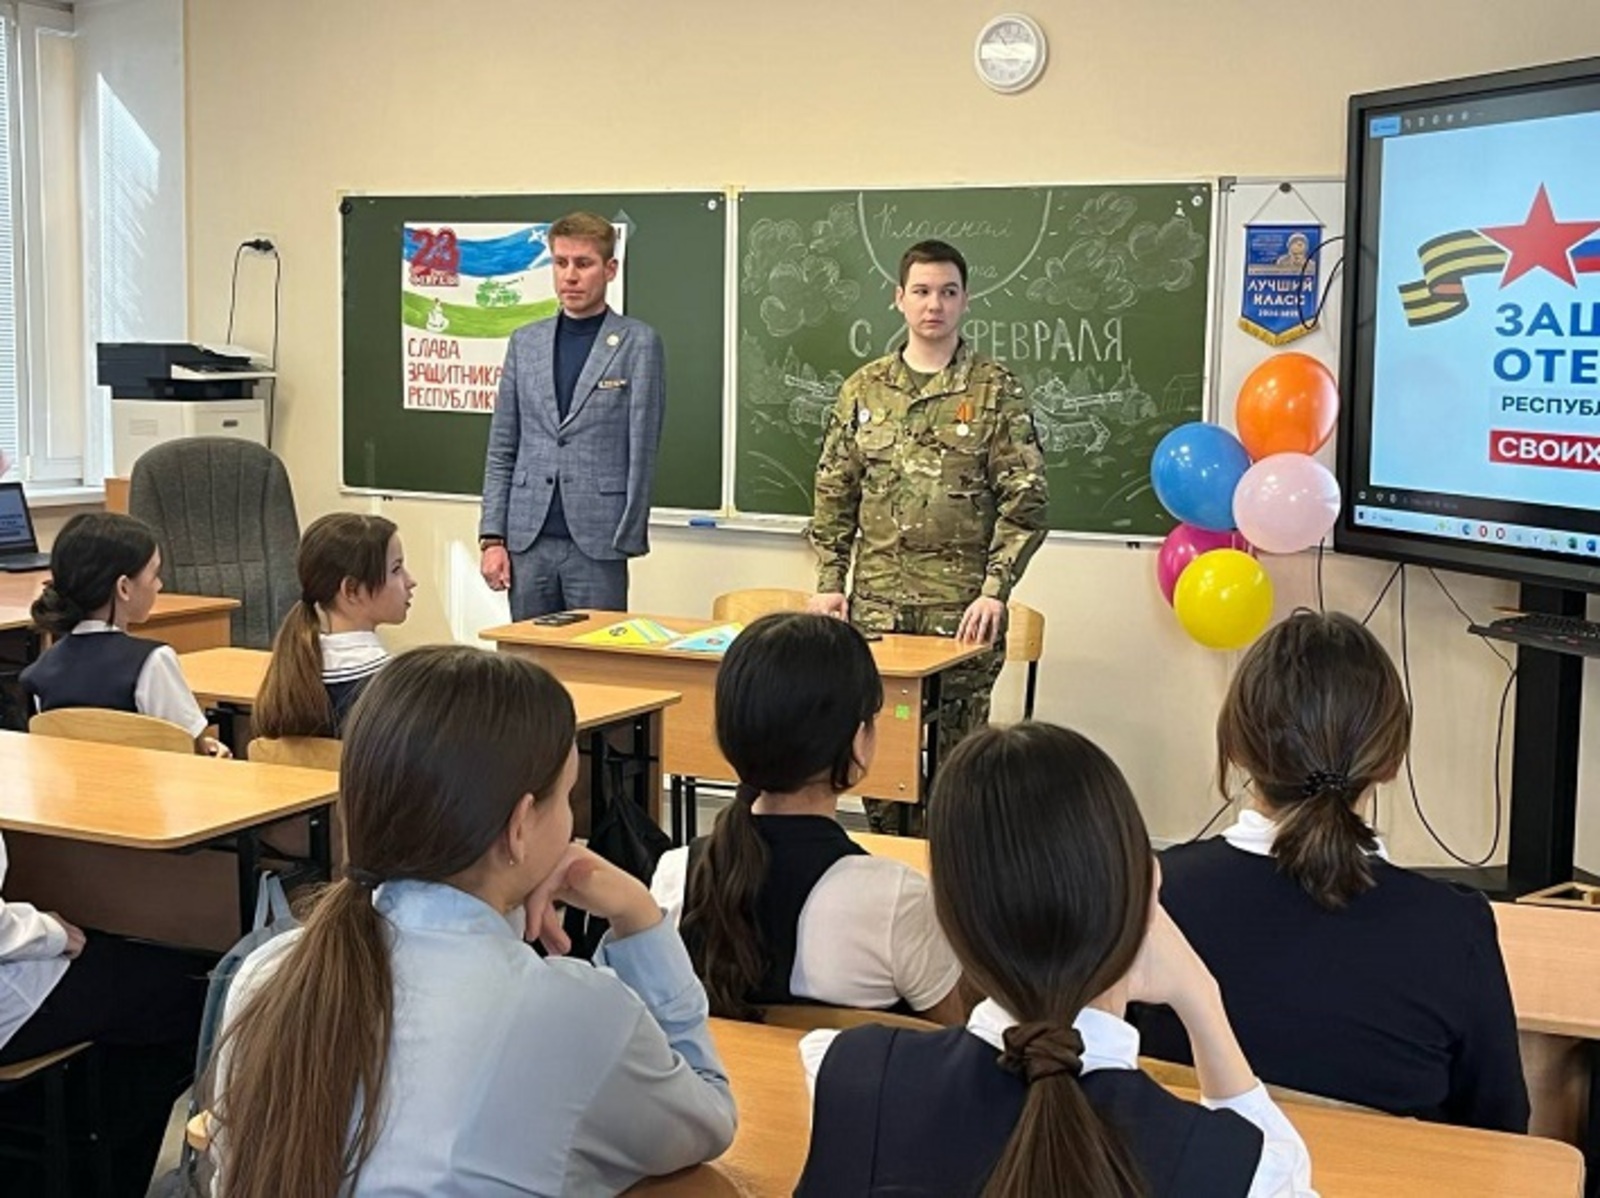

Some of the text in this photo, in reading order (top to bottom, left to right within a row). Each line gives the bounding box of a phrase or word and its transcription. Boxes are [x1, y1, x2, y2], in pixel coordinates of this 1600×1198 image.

[411, 227, 459, 274] 23
[1247, 277, 1312, 291] ЛУЧШИЙ
[1254, 294, 1305, 305] КЛАСС
[408, 338, 460, 359] СЛАВА
[850, 319, 872, 358] С
[961, 317, 1123, 362] ФЕВРАЛЯ
[1493, 347, 1600, 384] ОТЕ
[408, 386, 497, 410] РЕСПУБЛИК
[1498, 437, 1600, 465] СВОИХ
